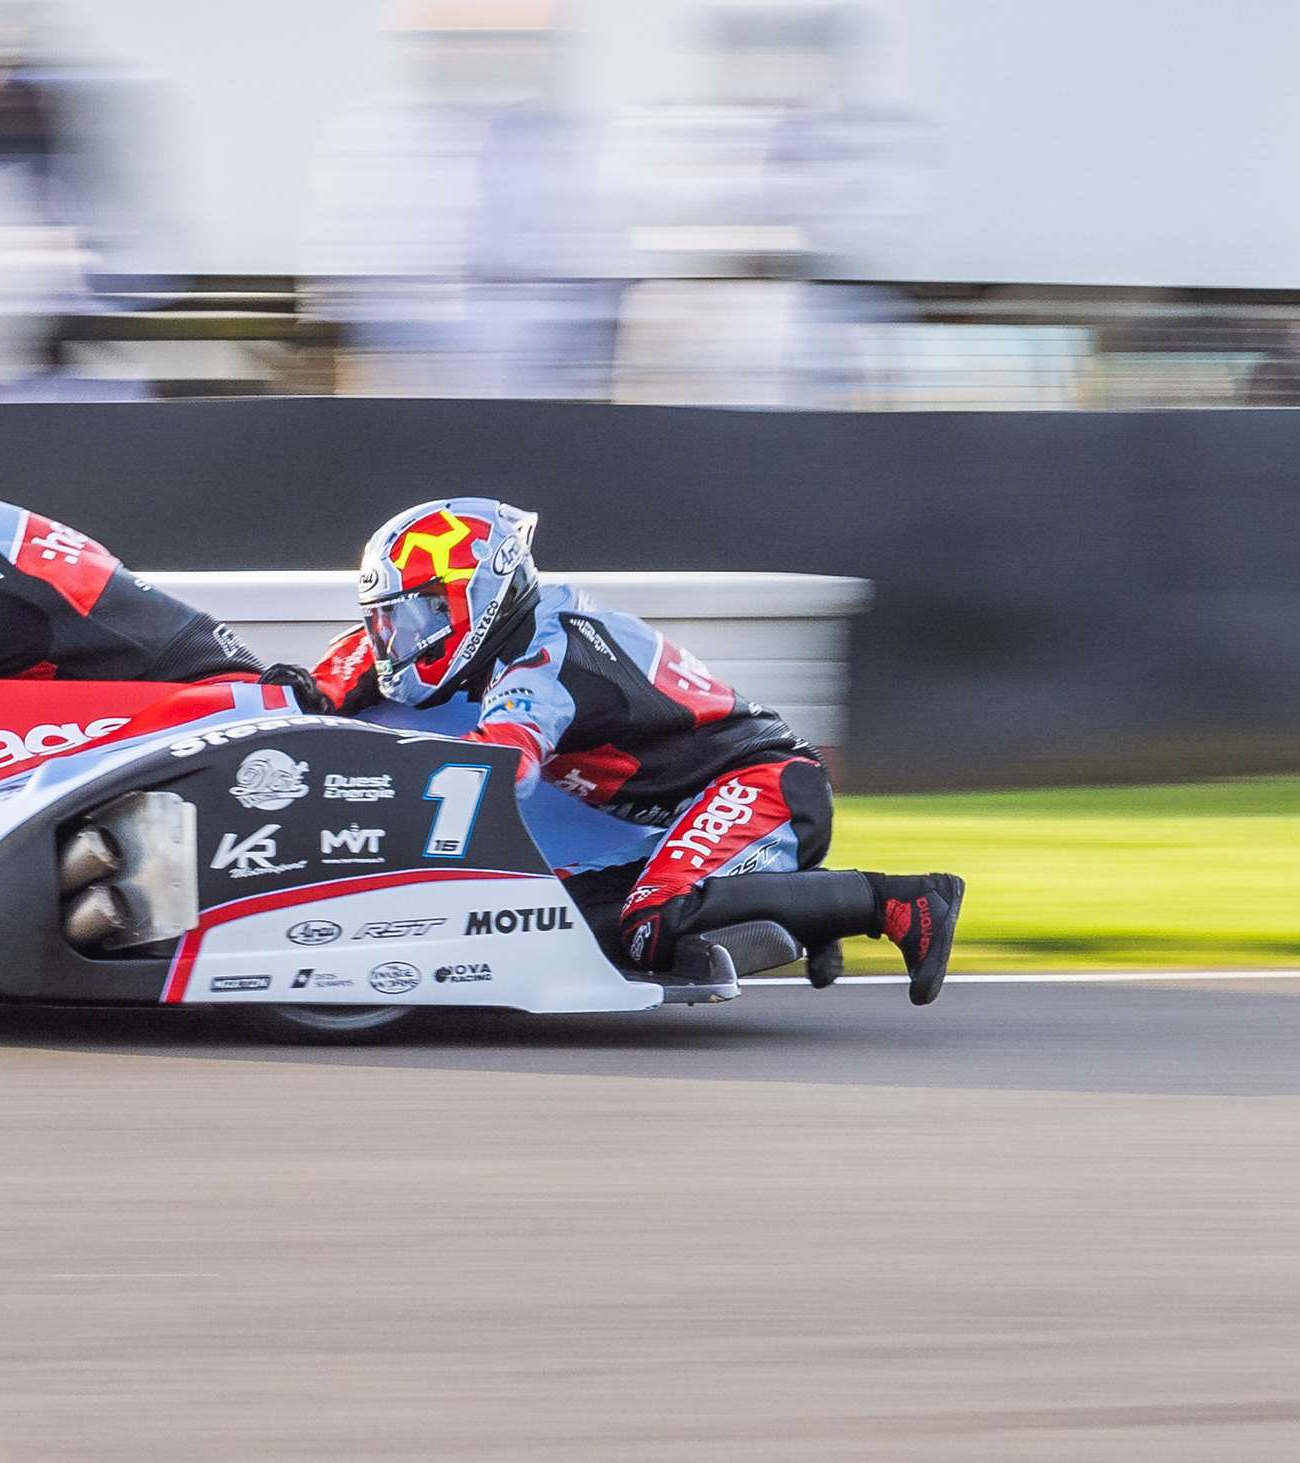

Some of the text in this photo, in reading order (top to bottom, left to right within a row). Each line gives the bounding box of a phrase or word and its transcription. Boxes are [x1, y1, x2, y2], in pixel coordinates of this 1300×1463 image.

[422, 763, 492, 859] 1
[320, 829, 386, 854] MVT
[351, 918, 448, 940] RST
[464, 906, 574, 936] MOTUL
